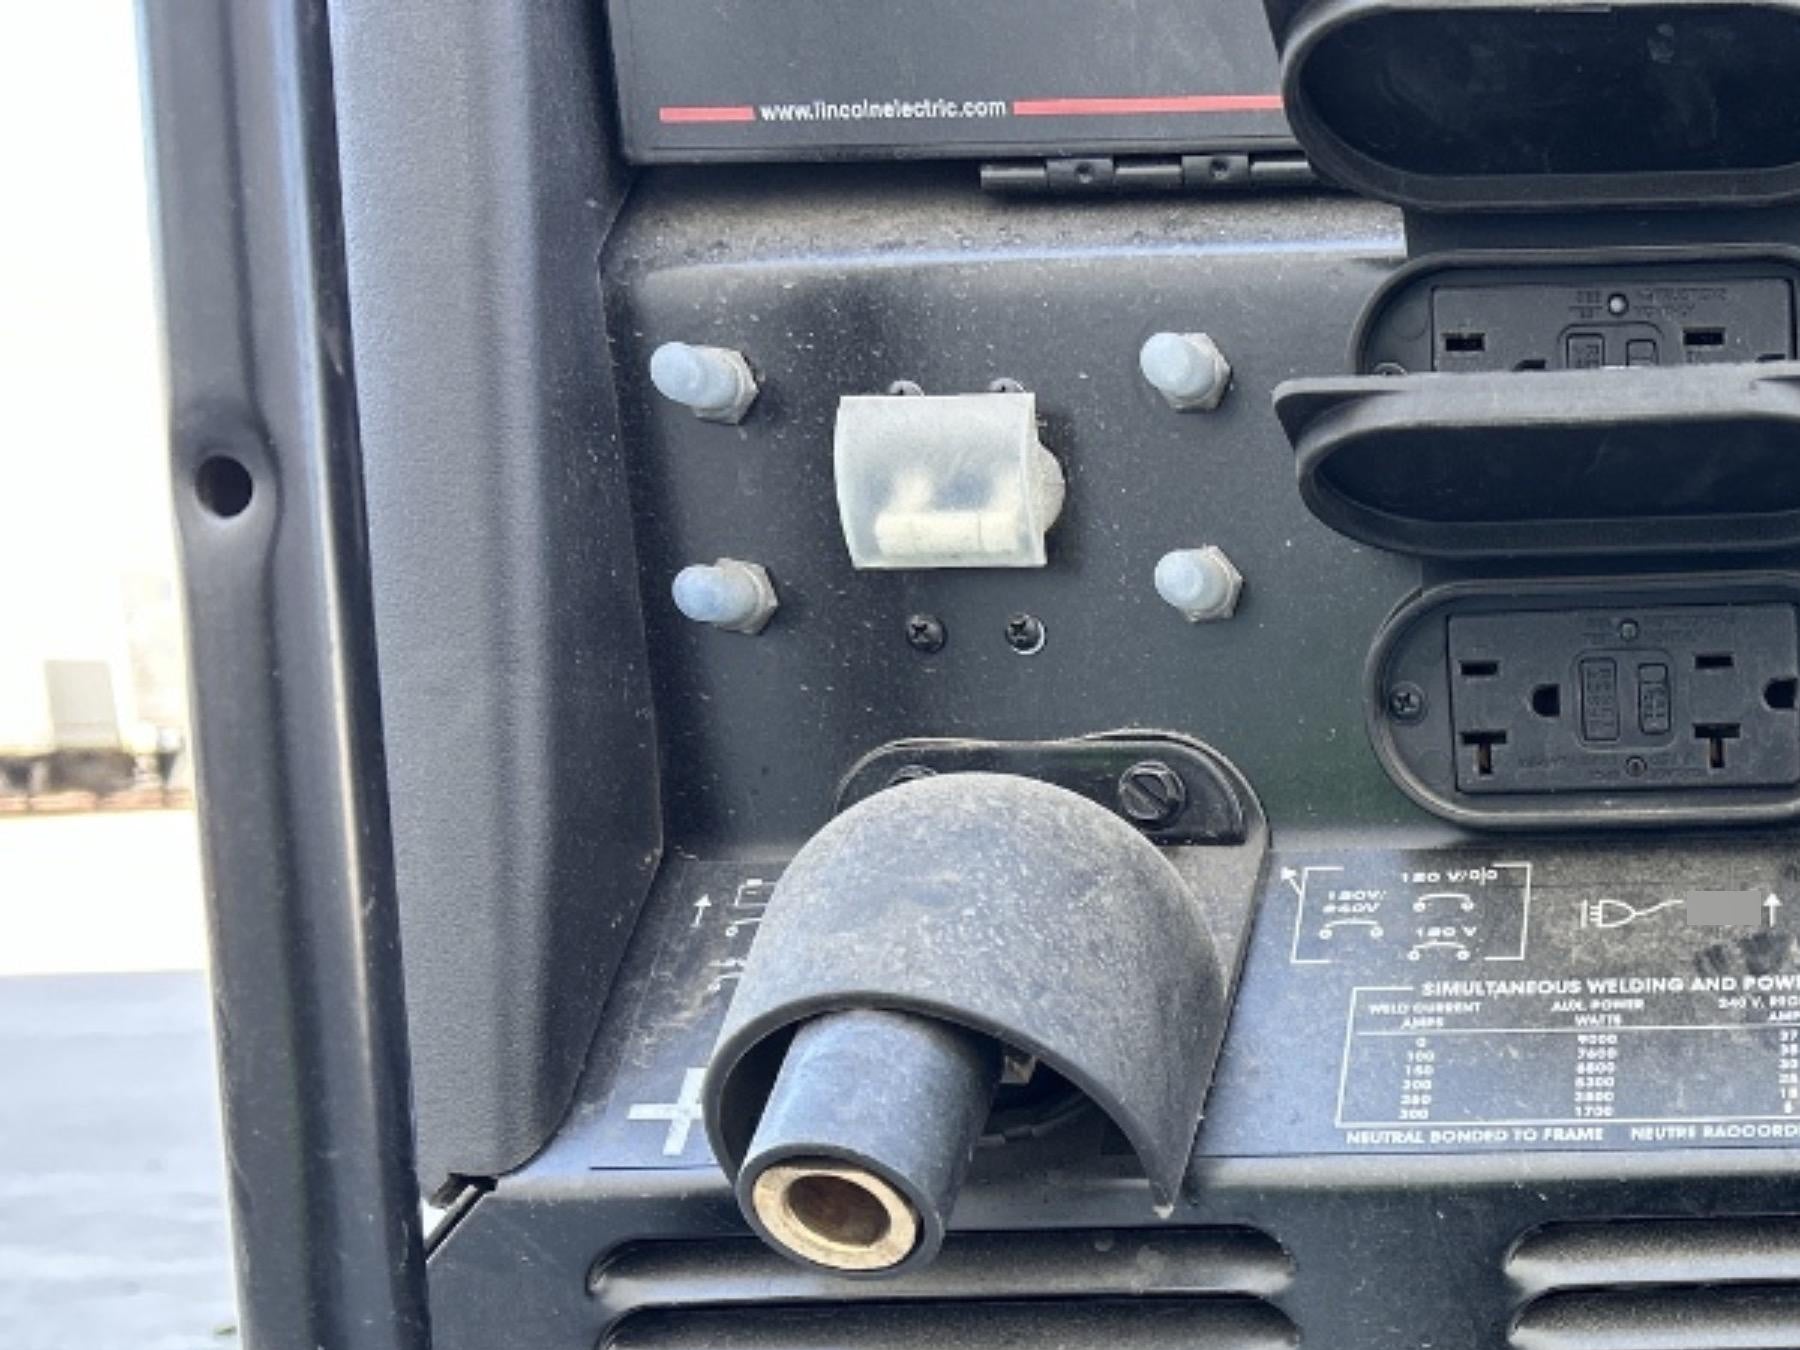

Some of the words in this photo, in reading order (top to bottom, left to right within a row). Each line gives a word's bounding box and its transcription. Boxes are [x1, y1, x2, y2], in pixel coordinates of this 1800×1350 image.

[759, 97, 1008, 122] www.lincolnelectric.com
[1463, 926, 1478, 937] V
[1421, 977, 1582, 997] SIMULTANEOUS
[1586, 976, 1685, 995] WELDING
[1691, 975, 1738, 992] AND
[1368, 1001, 1409, 1015] WELD
[1413, 1000, 1482, 1014] CURRENT
[1590, 998, 1644, 1011] POWER
[1401, 1016, 1444, 1028] AMPS
[1574, 1013, 1621, 1027] WATTS
[1347, 1128, 1424, 1145] NEUTRAL
[1430, 1128, 1509, 1144] BONDED
[1513, 1127, 1537, 1142] TO
[1541, 1126, 1604, 1141] FRAME
[1631, 1123, 1696, 1142] NEUTRE
